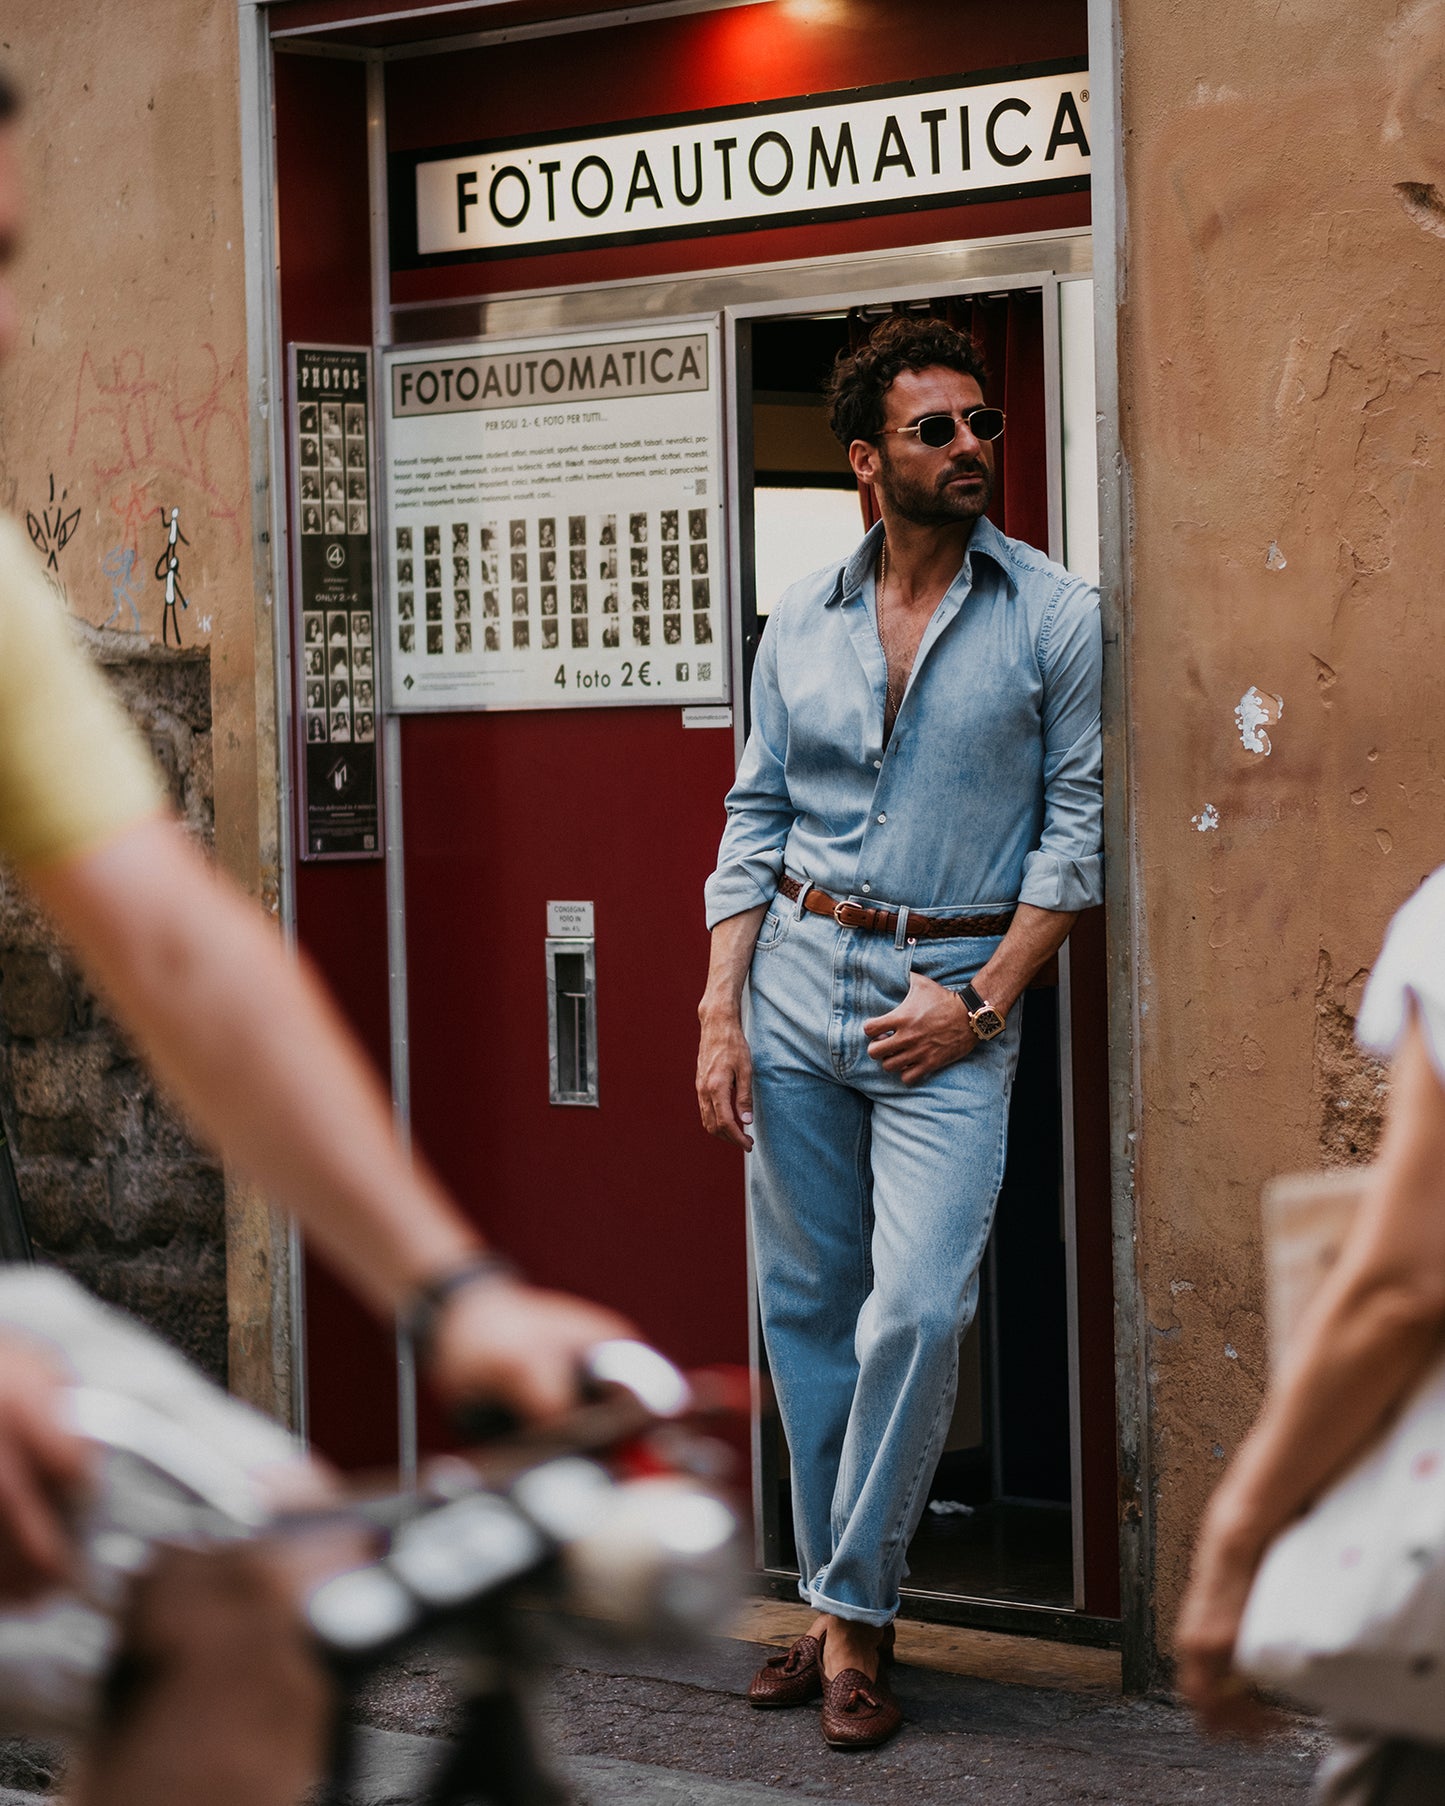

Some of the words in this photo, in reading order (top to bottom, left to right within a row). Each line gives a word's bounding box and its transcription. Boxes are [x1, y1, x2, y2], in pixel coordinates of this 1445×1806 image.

[302, 367, 360, 390] PHOTOS
[485, 420, 499, 431] PER
[500, 419, 518, 430] SOLI
[543, 415, 565, 427] FOTO
[567, 413, 581, 424] PER
[328, 547, 343, 566] 4
[315, 593, 338, 602] ONLY
[554, 664, 567, 689] 4
[576, 670, 611, 688] foto
